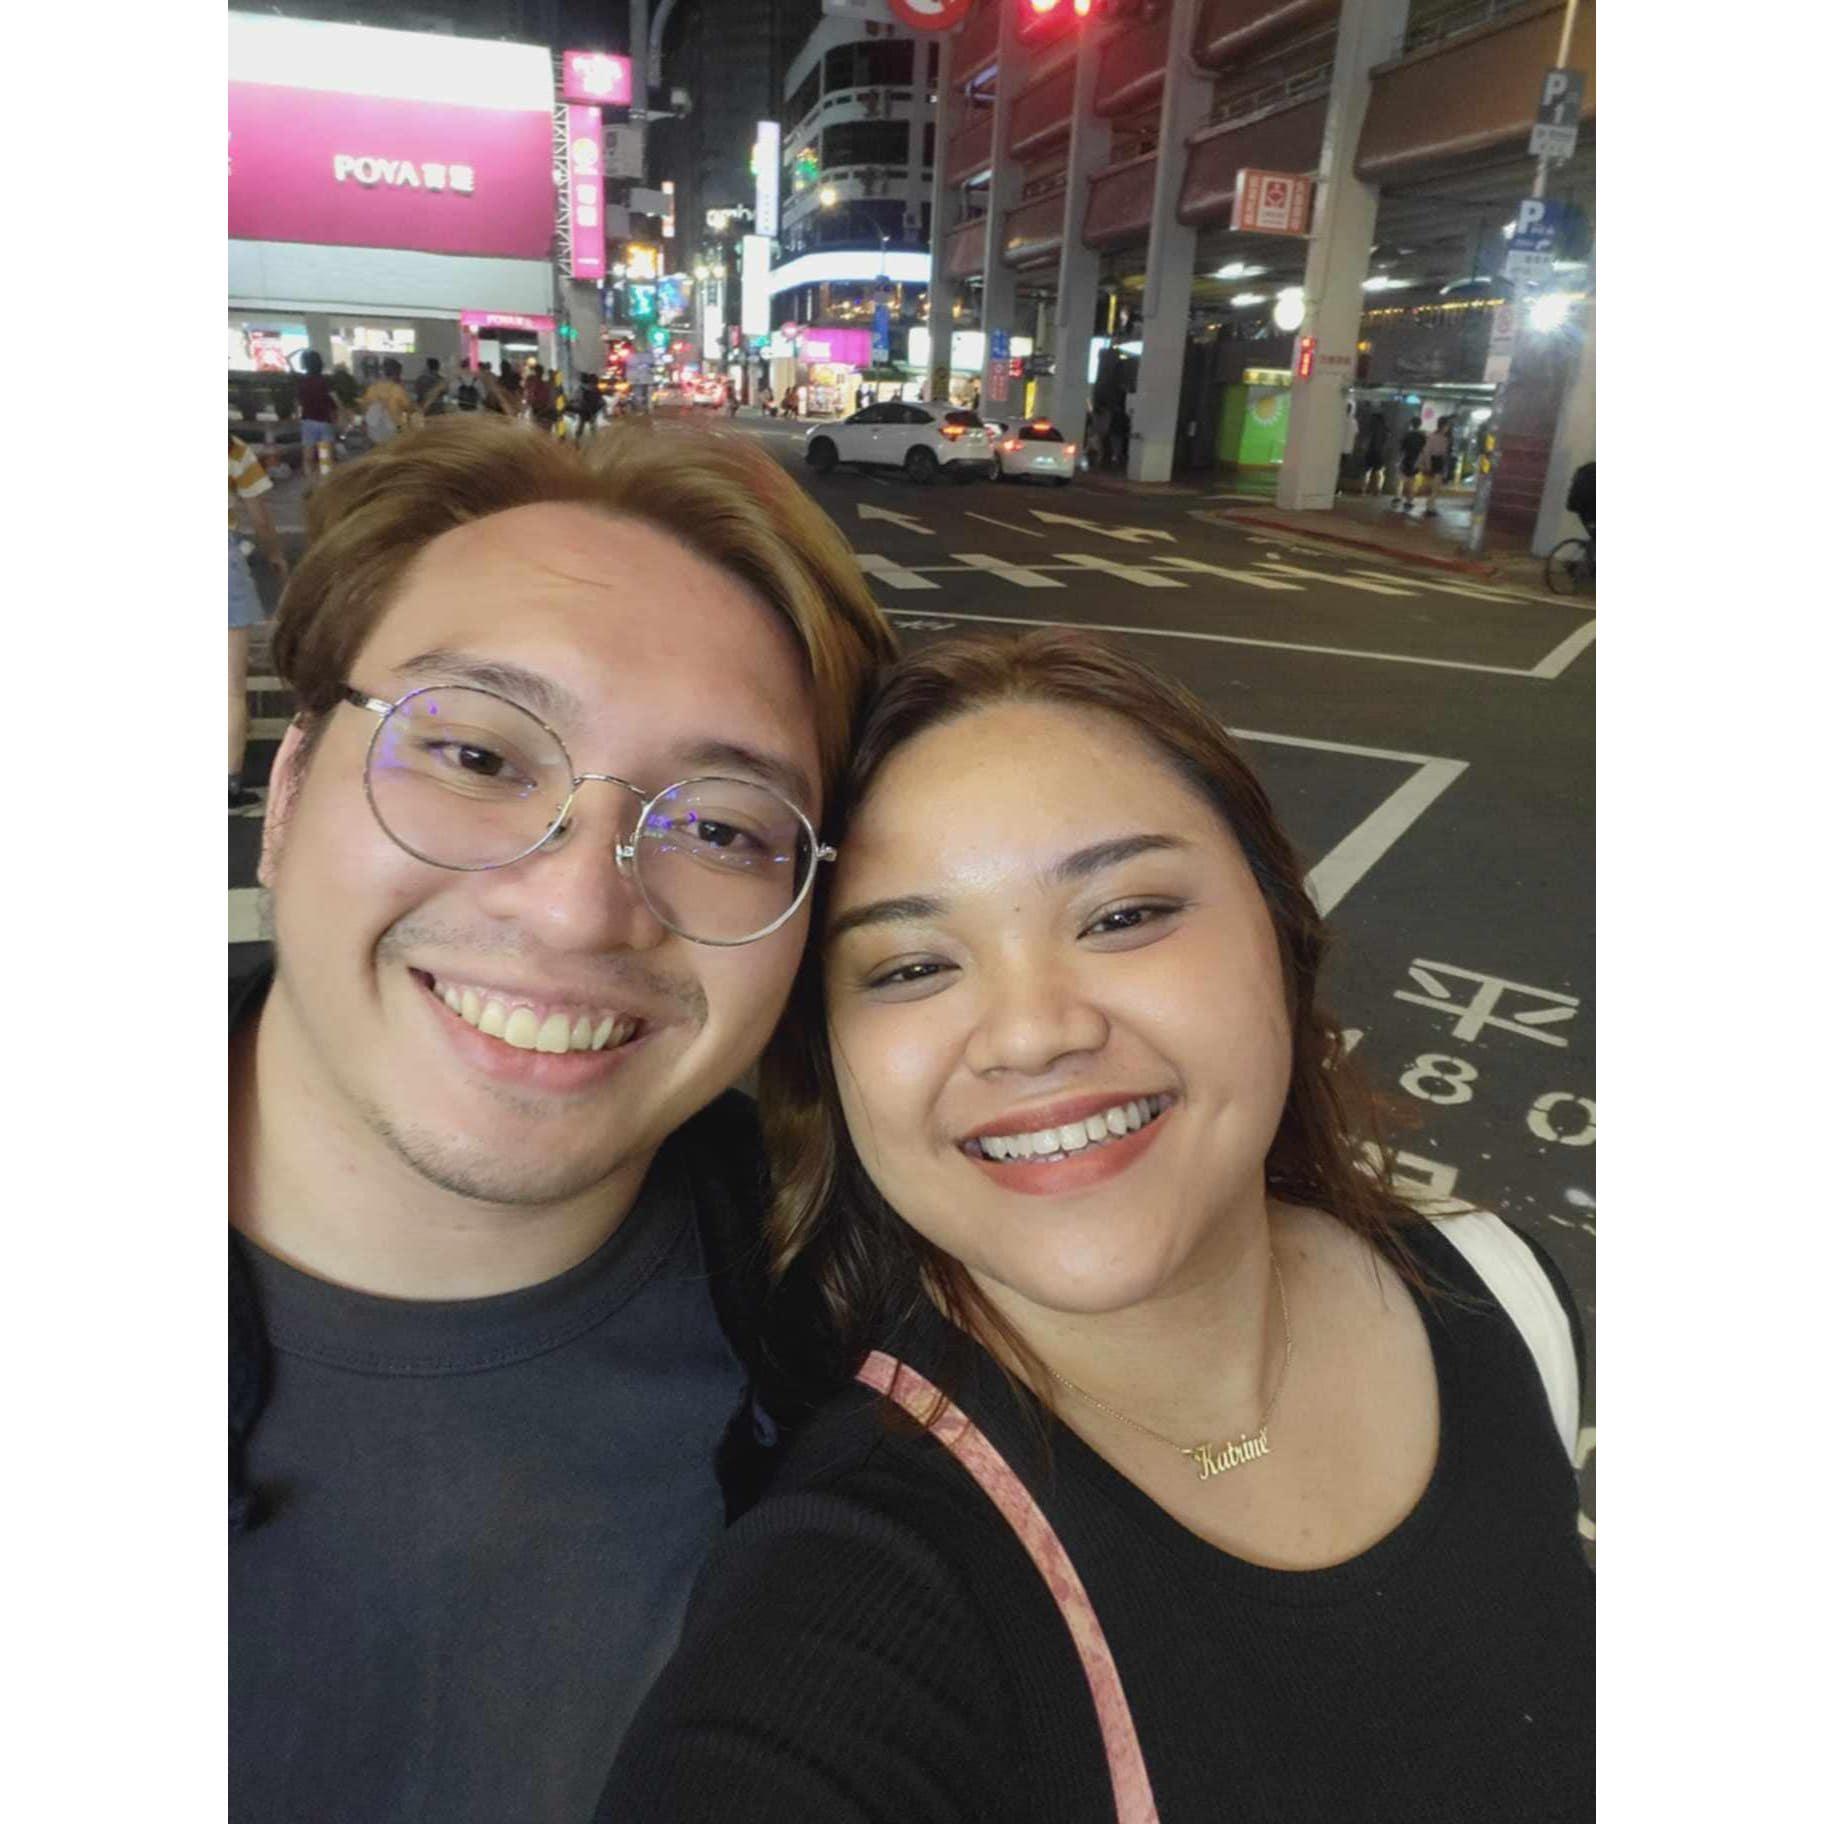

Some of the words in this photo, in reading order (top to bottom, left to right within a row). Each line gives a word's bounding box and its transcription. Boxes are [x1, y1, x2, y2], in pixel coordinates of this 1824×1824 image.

[1542, 73, 1568, 106] P
[333, 154, 420, 188] POYA
[1518, 200, 1545, 234] P
[1393, 957, 1581, 1048] 平
